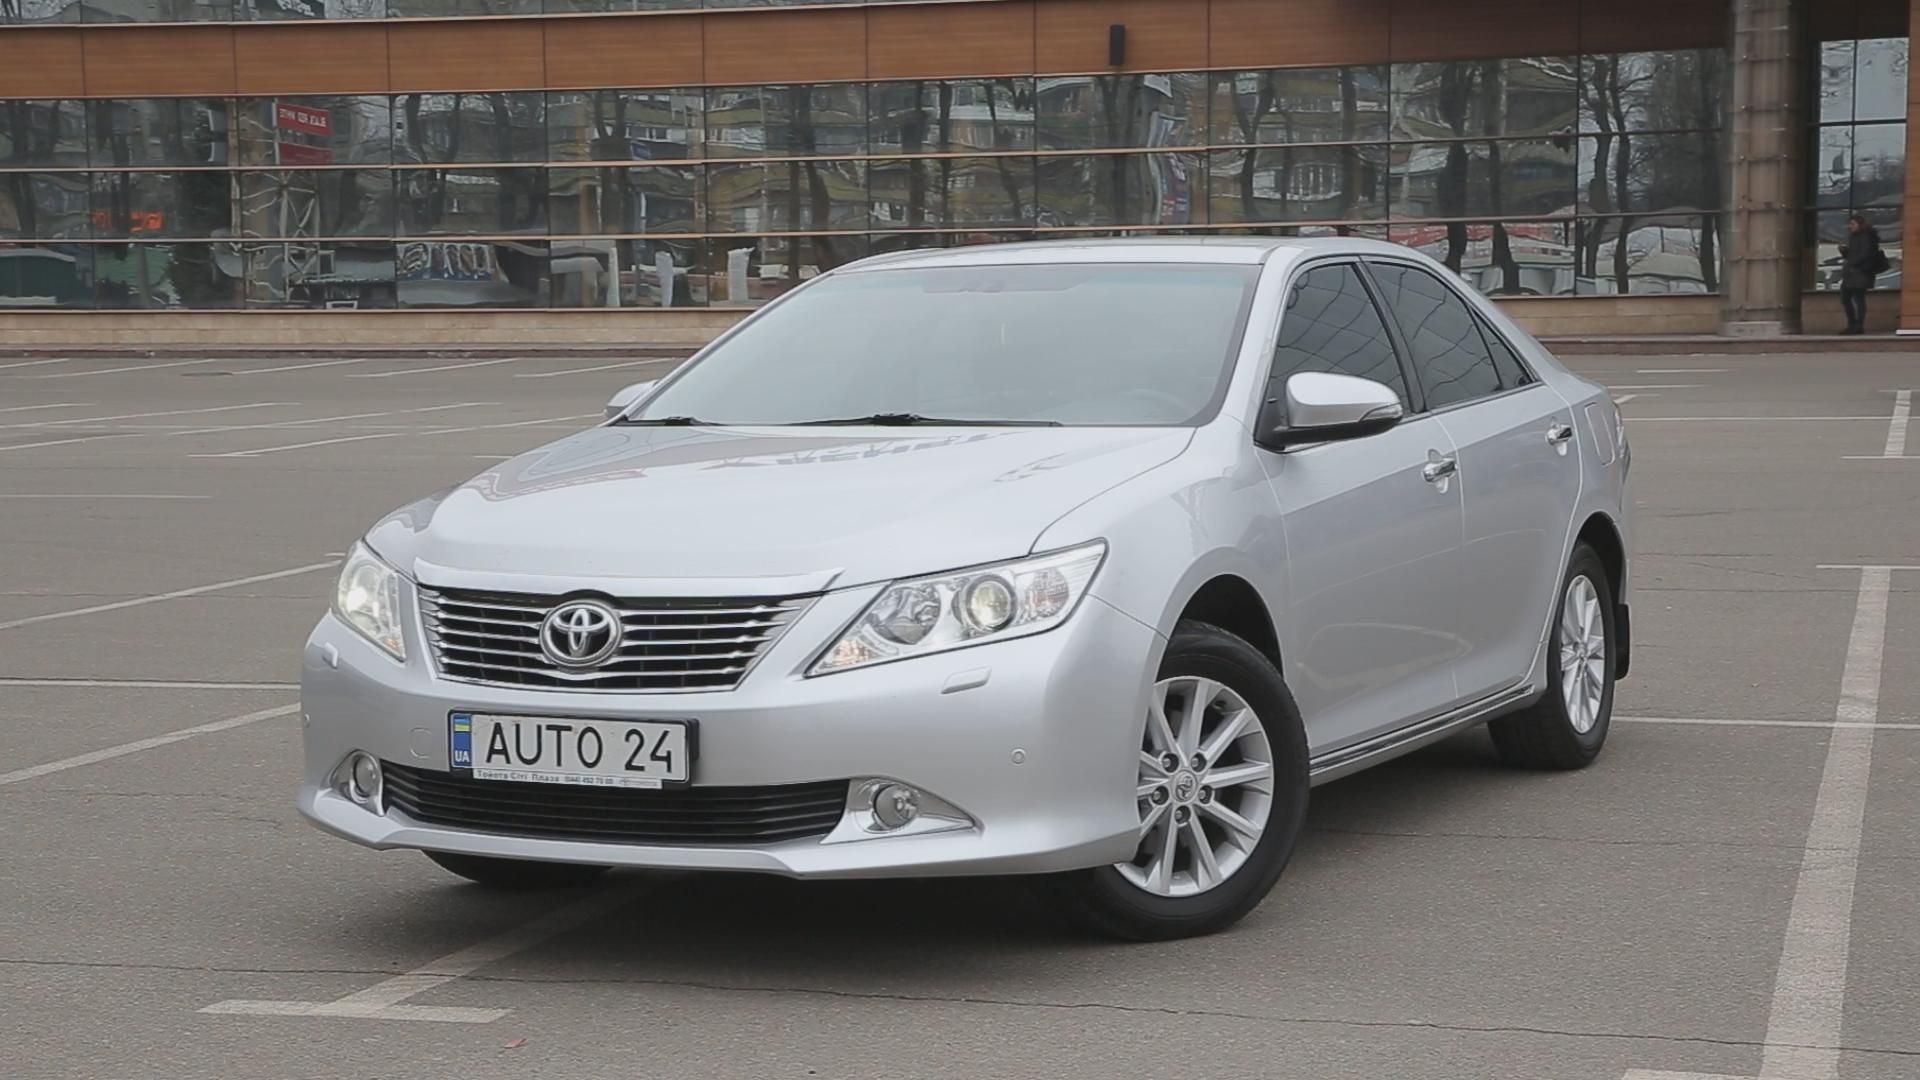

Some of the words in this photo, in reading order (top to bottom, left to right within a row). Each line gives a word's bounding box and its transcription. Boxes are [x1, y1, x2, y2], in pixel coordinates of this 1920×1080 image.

[454, 750, 470, 763] UA
[486, 722, 602, 768] AUTO
[624, 728, 673, 774] 24
